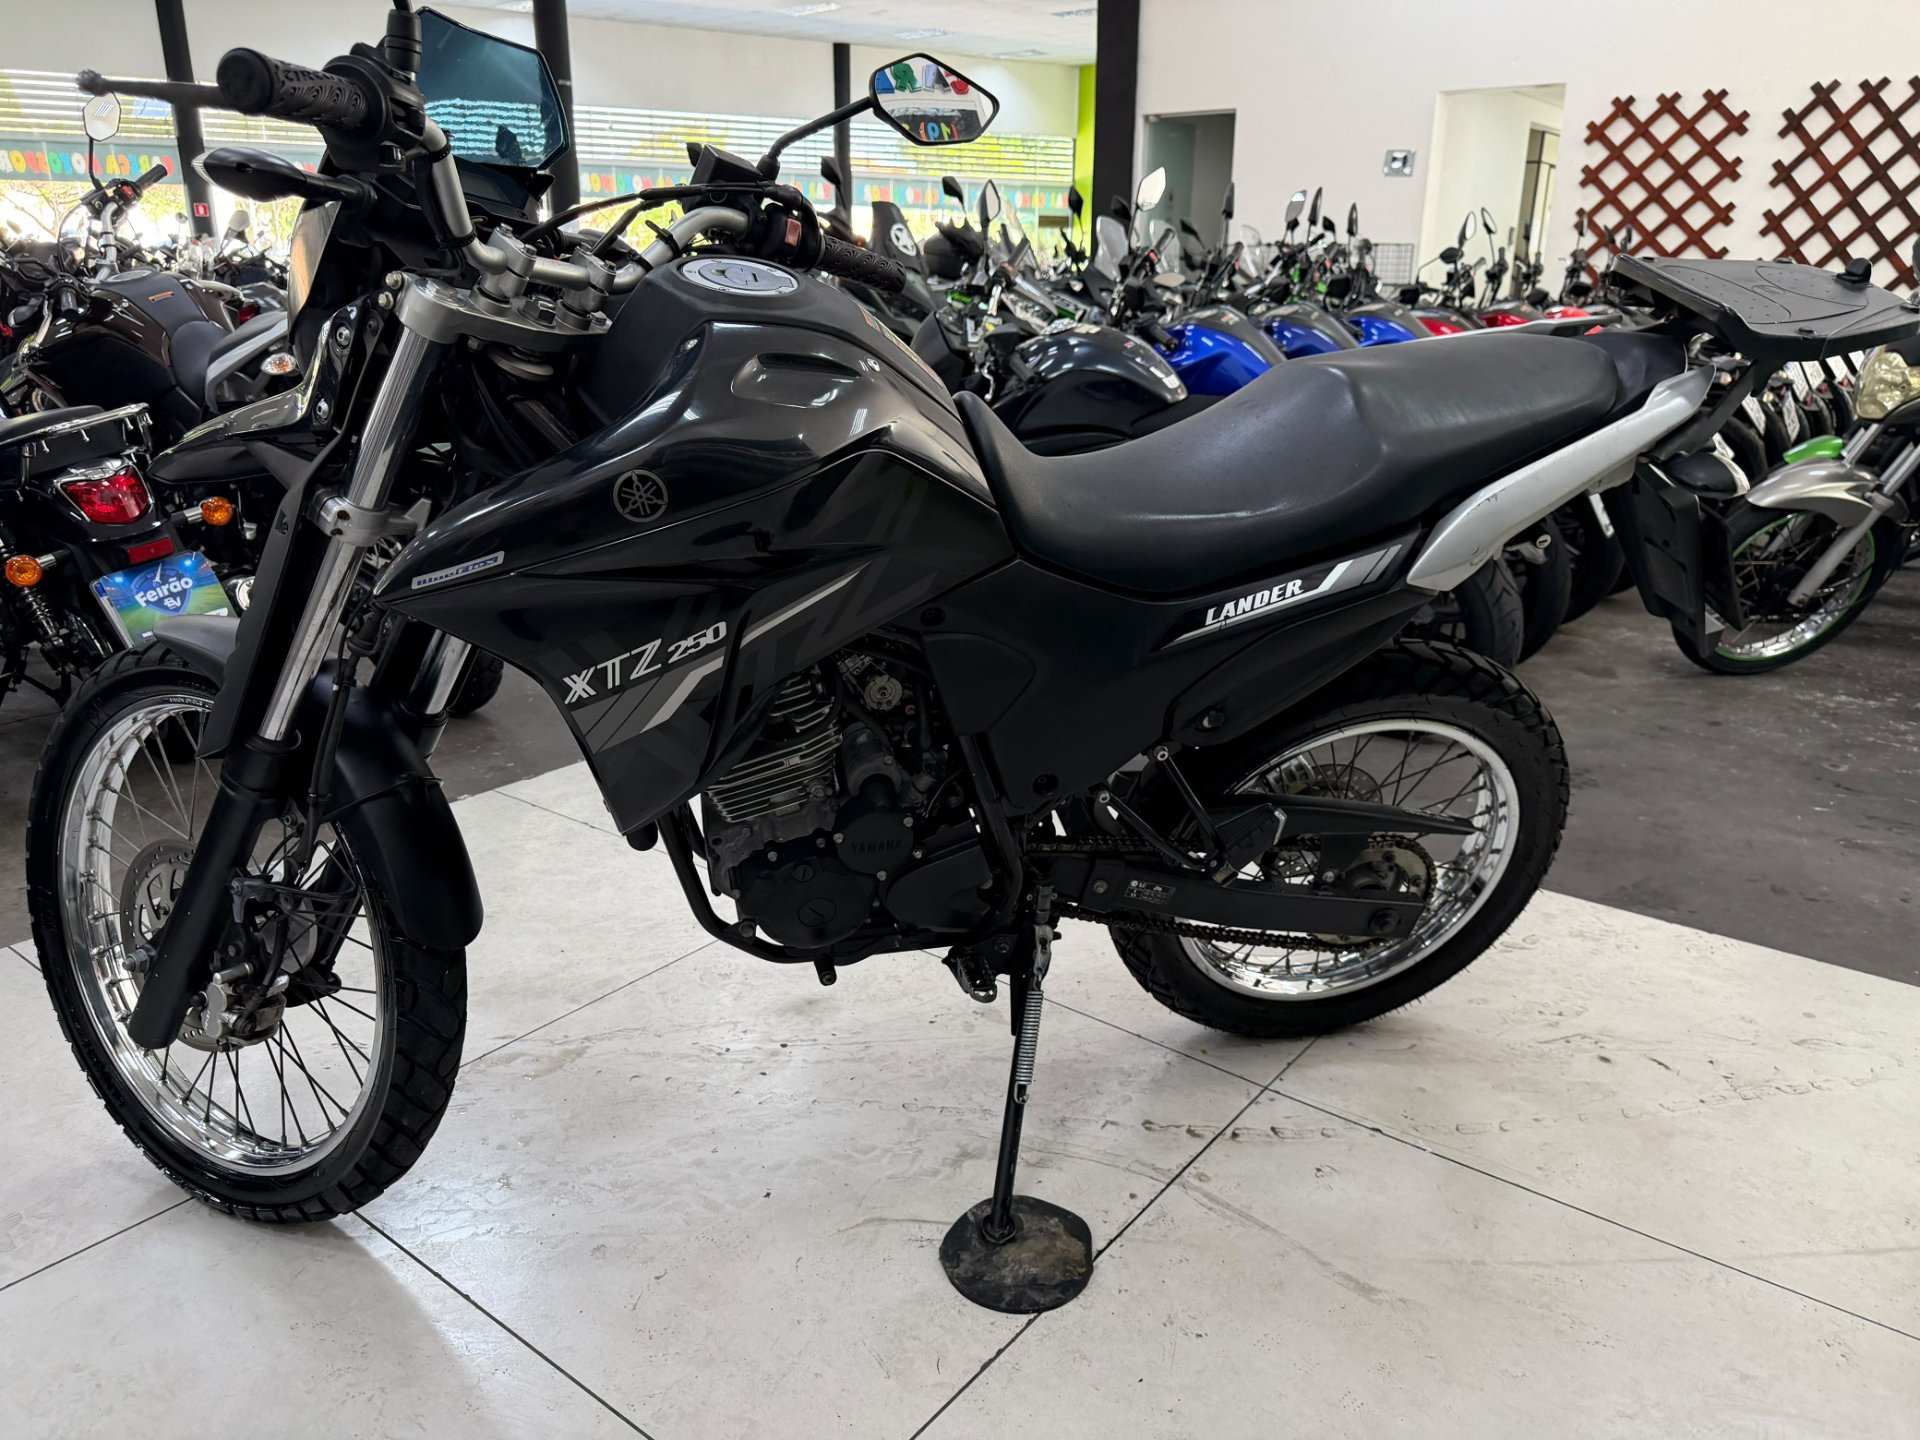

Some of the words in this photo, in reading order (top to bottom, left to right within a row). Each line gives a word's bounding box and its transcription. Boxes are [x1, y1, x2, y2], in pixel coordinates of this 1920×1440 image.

[134, 577, 193, 608] Feirão
[1205, 578, 1304, 626] LANDER
[562, 638, 662, 705] XTZ
[667, 621, 727, 664] 250
[851, 839, 902, 853] YAMAHA
